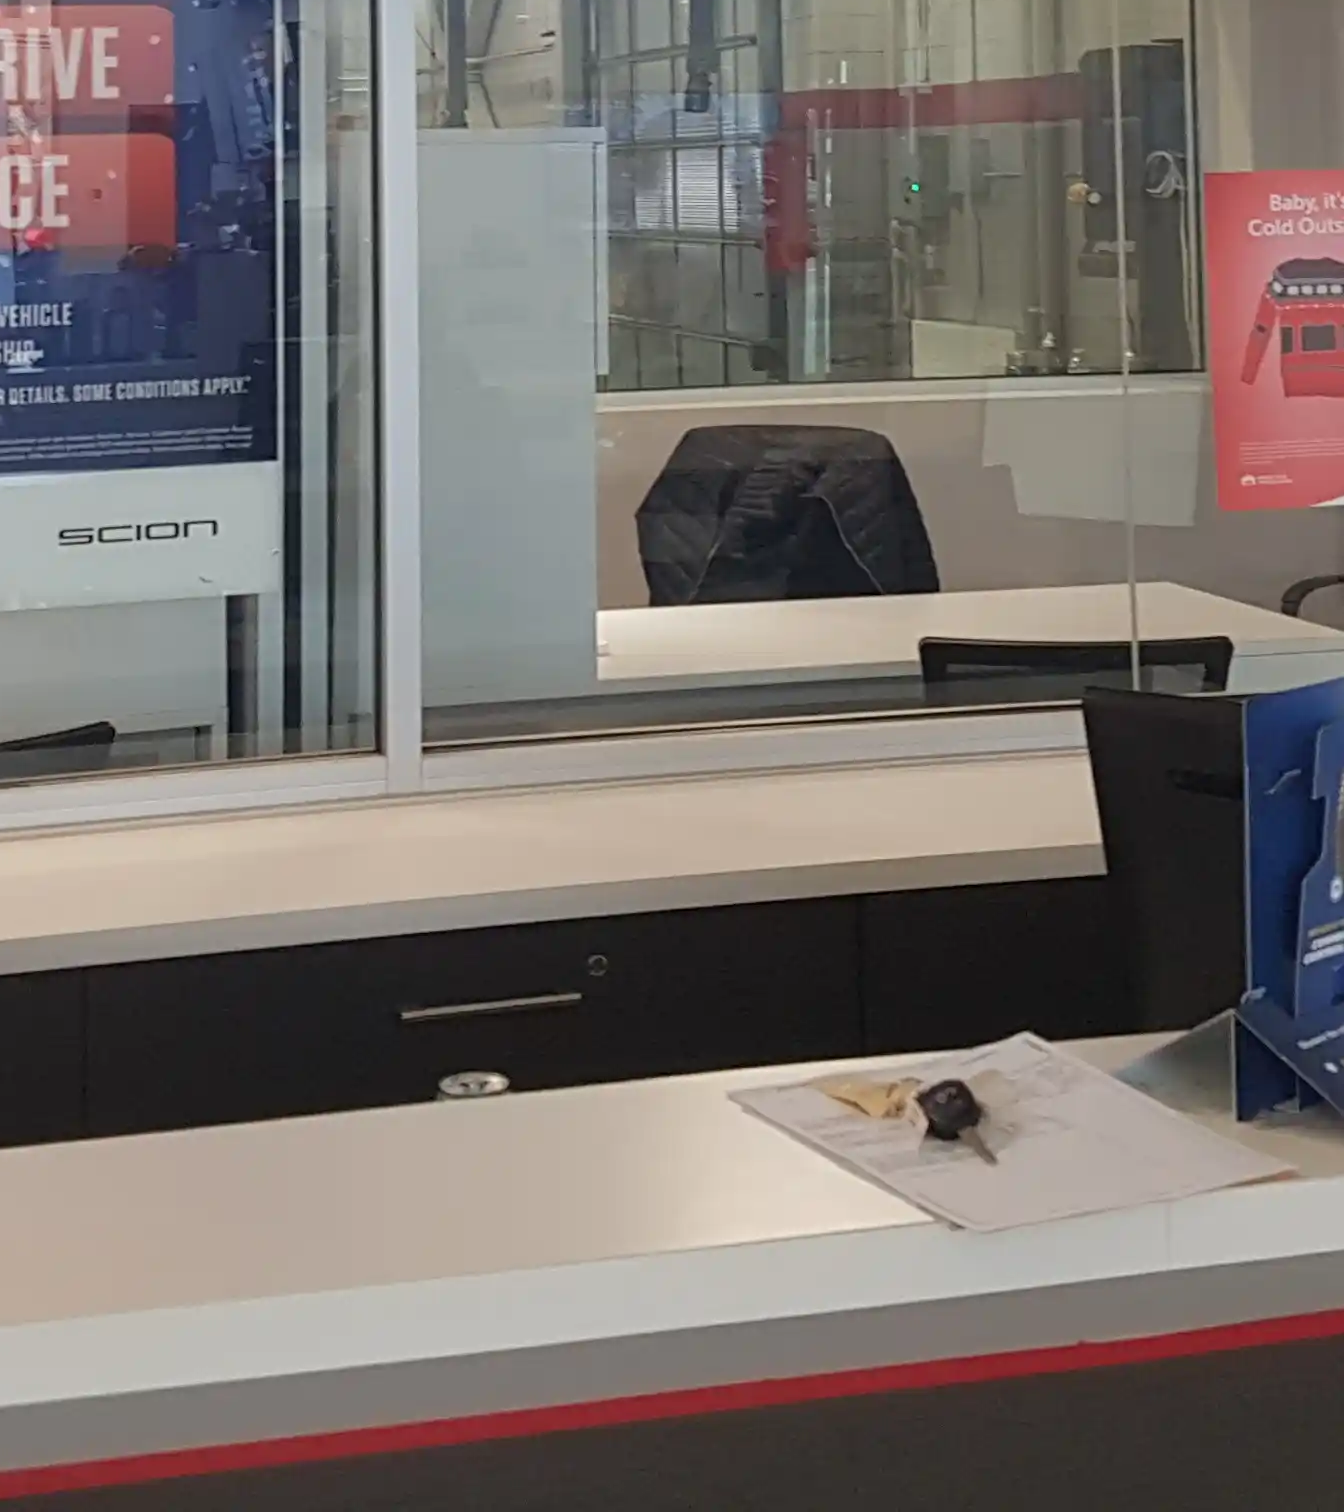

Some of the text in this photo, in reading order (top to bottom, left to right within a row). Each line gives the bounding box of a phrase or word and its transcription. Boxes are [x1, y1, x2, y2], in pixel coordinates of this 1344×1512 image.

[1269, 193, 1319, 215] Baby,
[1247, 218, 1295, 237] Cold
[73, 382, 114, 403] SOME
[116, 378, 200, 400] CONDITIONS
